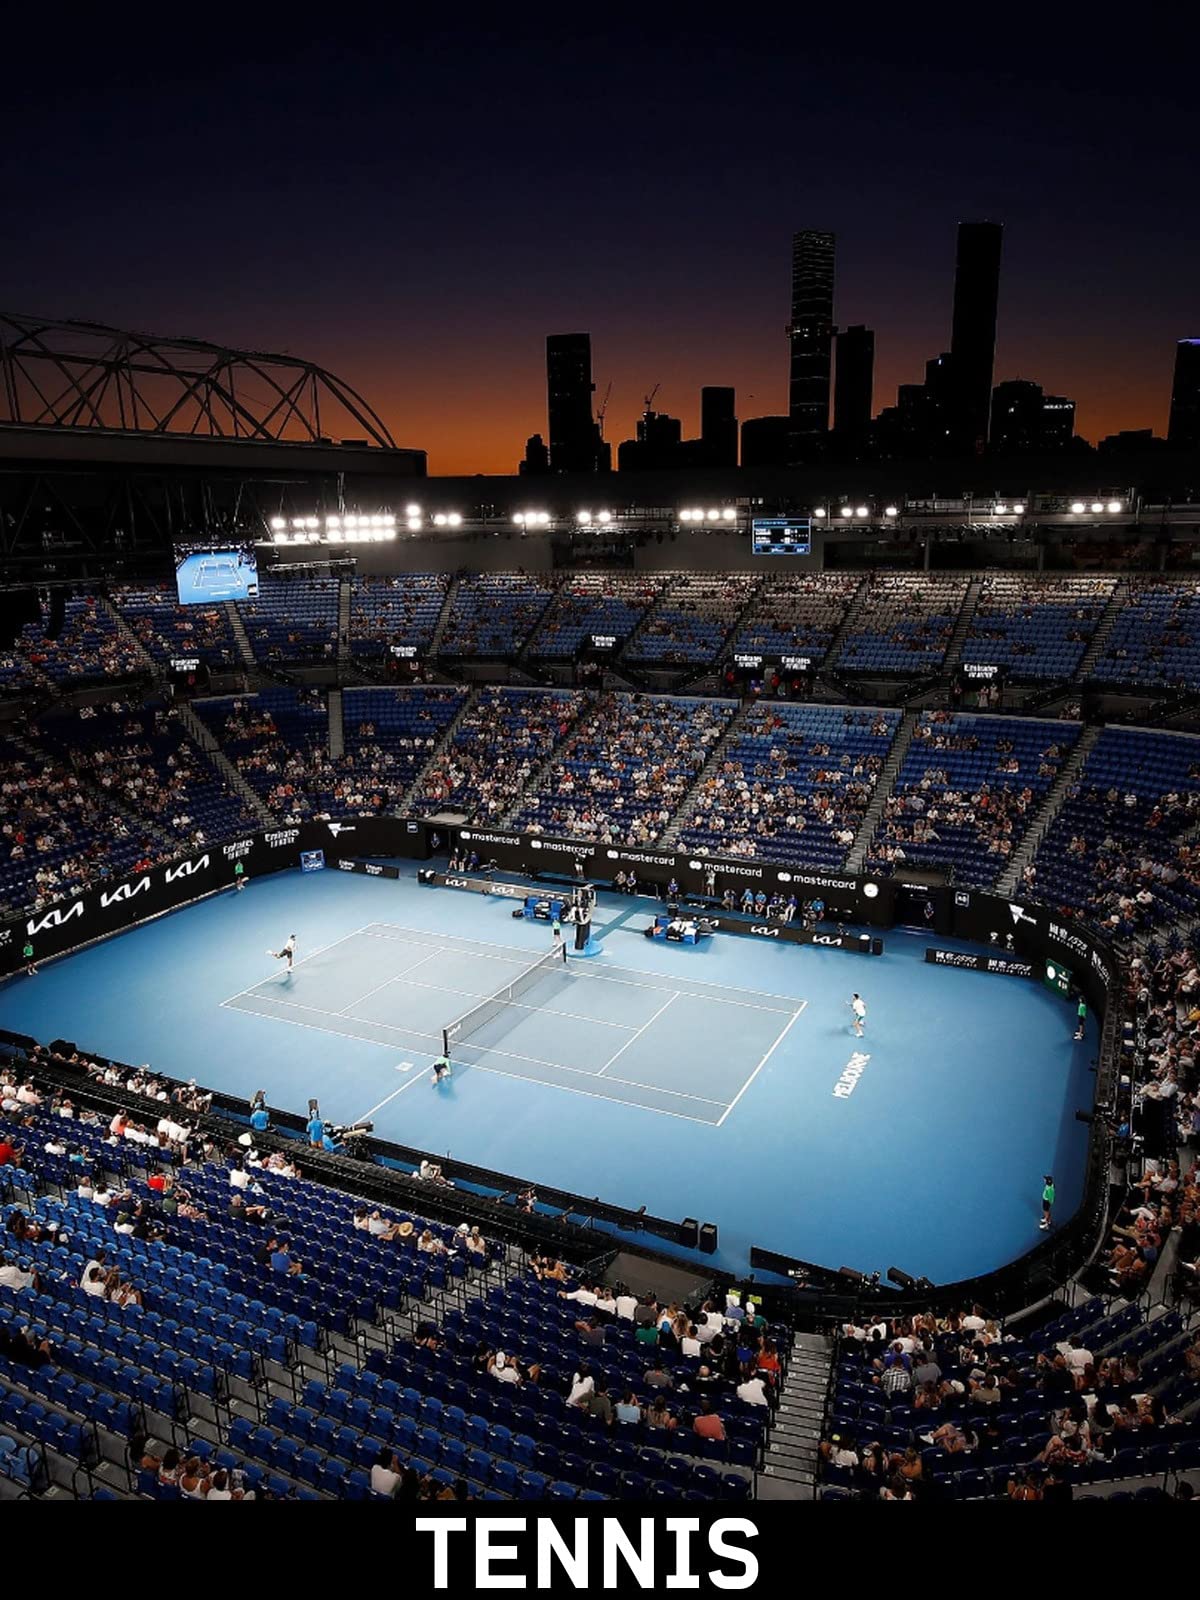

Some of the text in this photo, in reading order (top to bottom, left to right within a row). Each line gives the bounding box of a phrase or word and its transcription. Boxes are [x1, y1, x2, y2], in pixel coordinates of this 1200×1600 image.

[472, 832, 520, 846] mastercard
[543, 841, 595, 856] mastercard
[620, 851, 675, 866] mastercard
[165, 854, 210, 883] KIA
[704, 862, 763, 878] mastercard
[445, 878, 468, 887] KIA
[793, 873, 856, 890] mastercard
[100, 876, 151, 908] KIA
[491, 886, 514, 895] KIA
[27, 901, 84, 936] KIA
[751, 925, 779, 937] KIA
[813, 934, 842, 946] KIA
